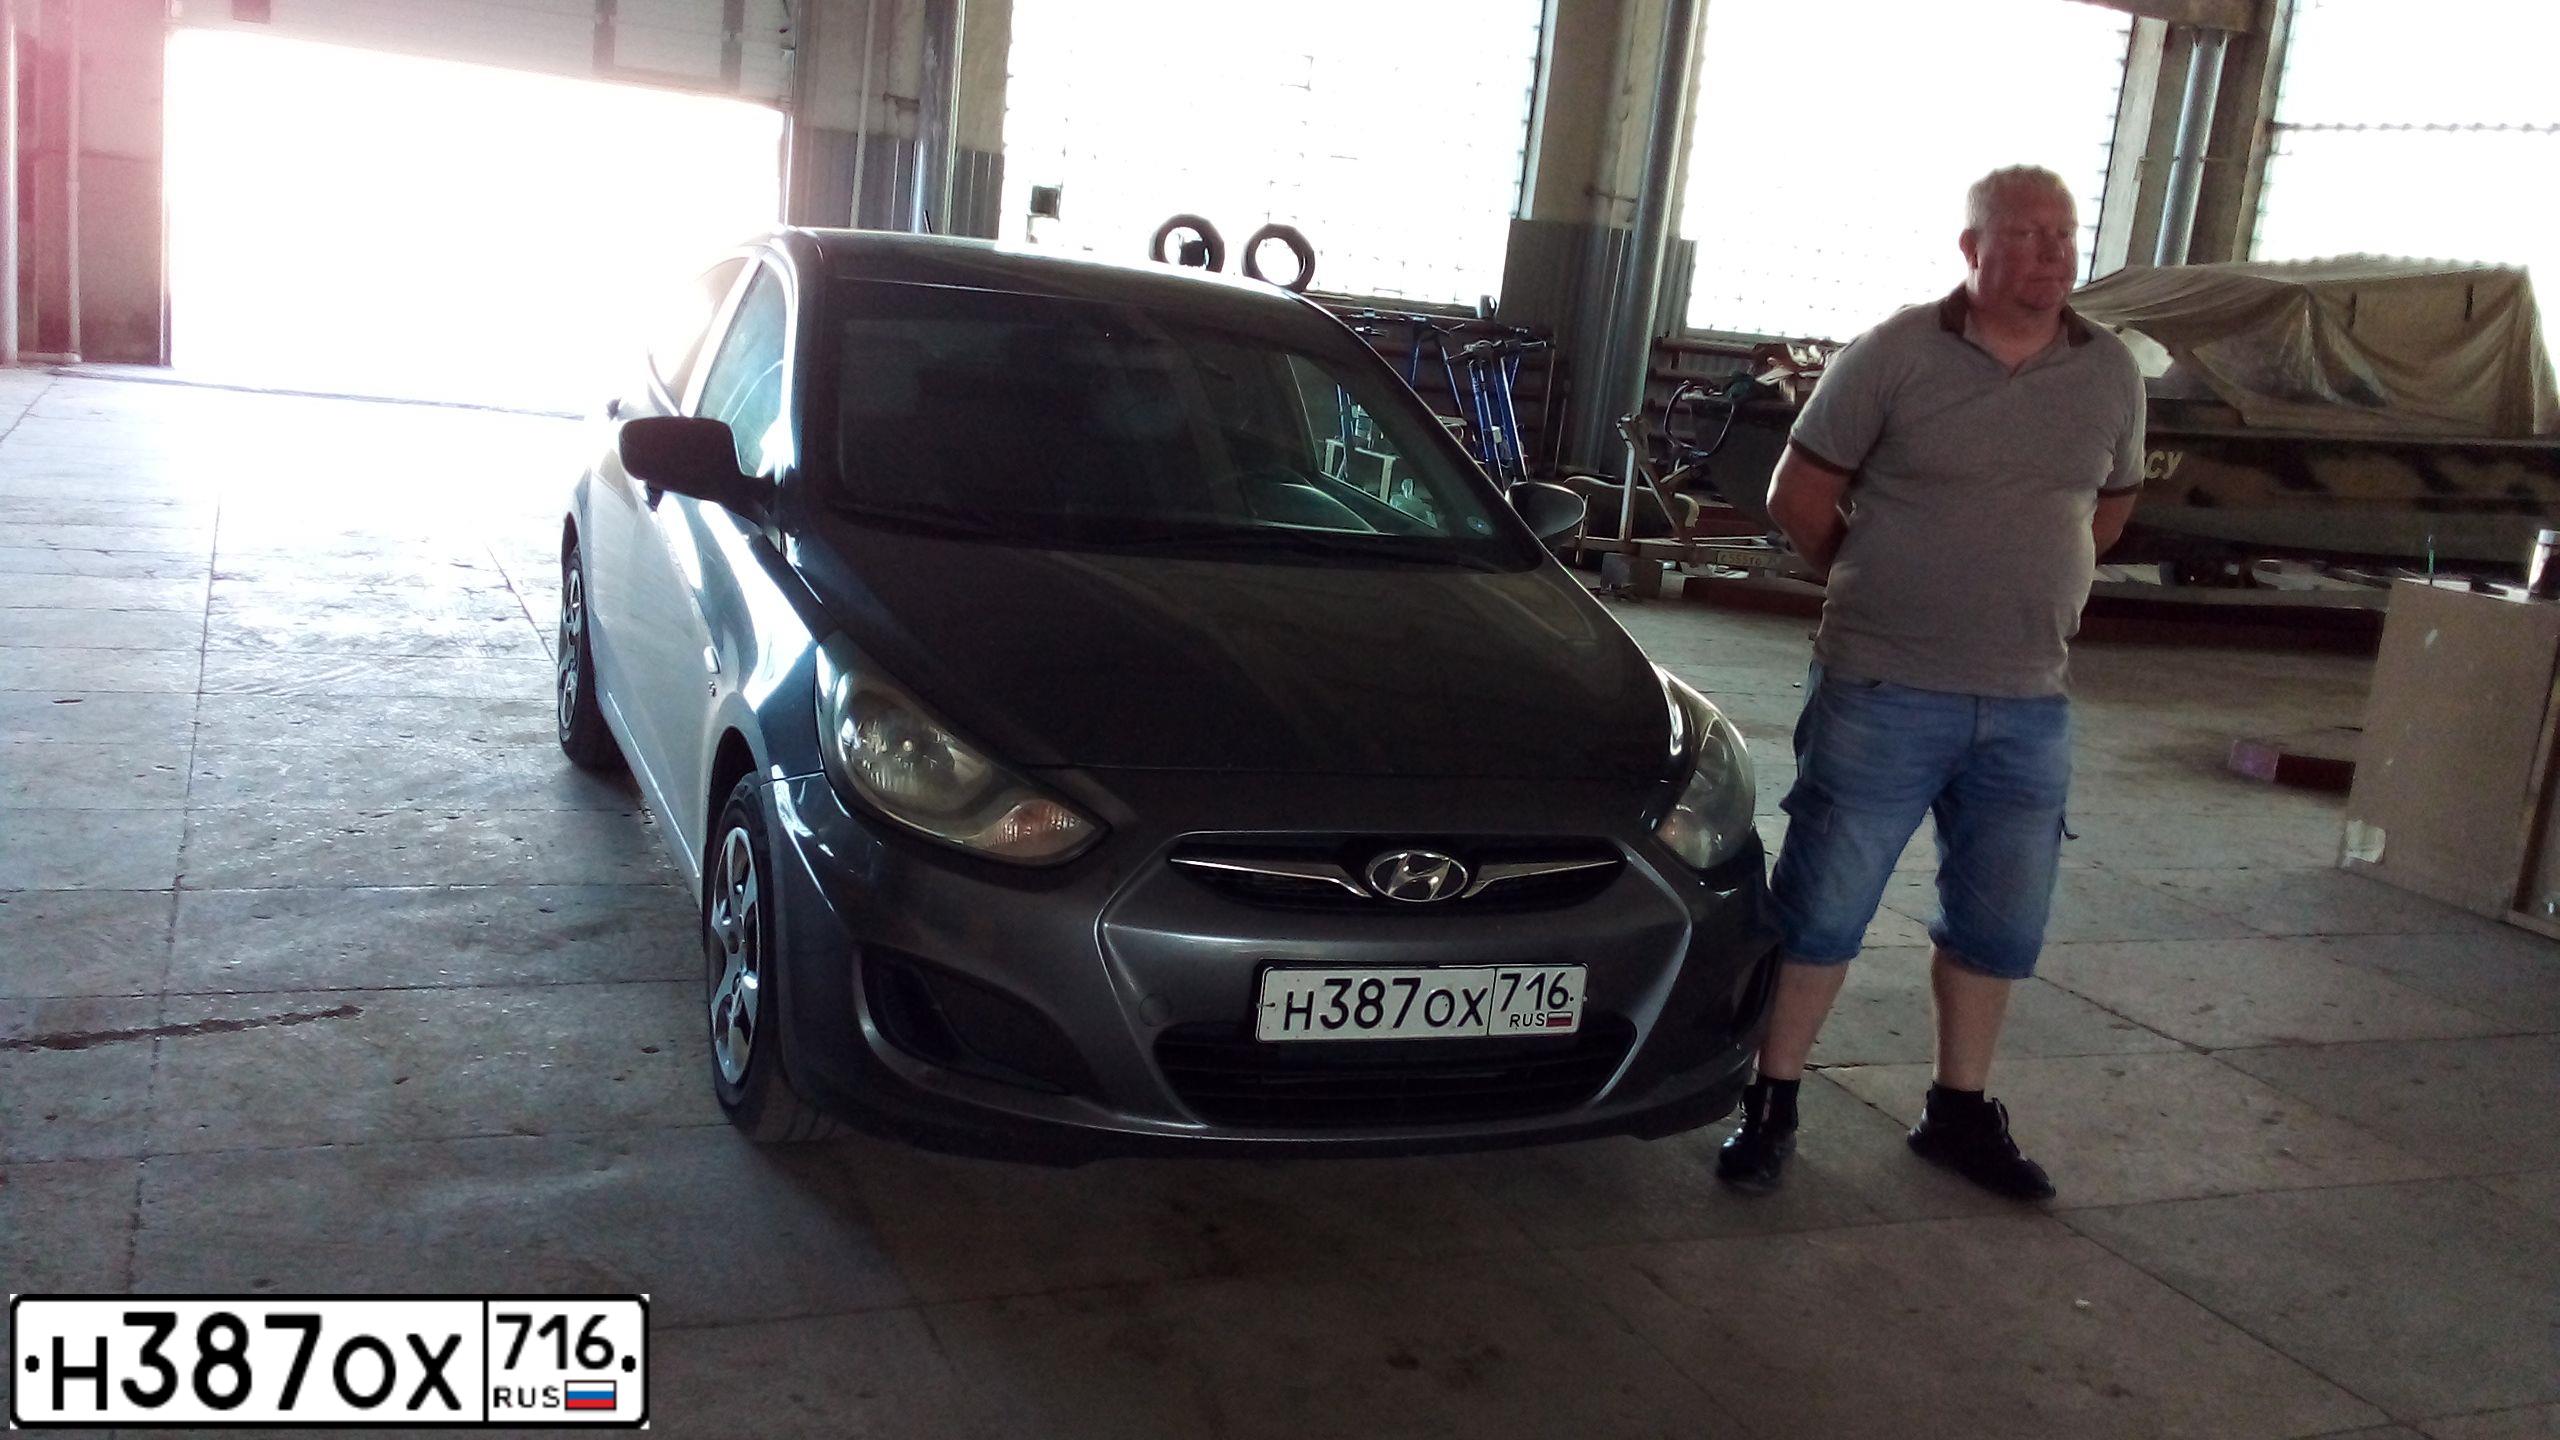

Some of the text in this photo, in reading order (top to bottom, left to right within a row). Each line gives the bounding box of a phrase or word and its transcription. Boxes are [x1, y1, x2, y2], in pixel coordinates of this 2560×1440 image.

[1283, 972, 1569, 1030] Н387ОХ 716
[1509, 1013, 1545, 1028] RUS
